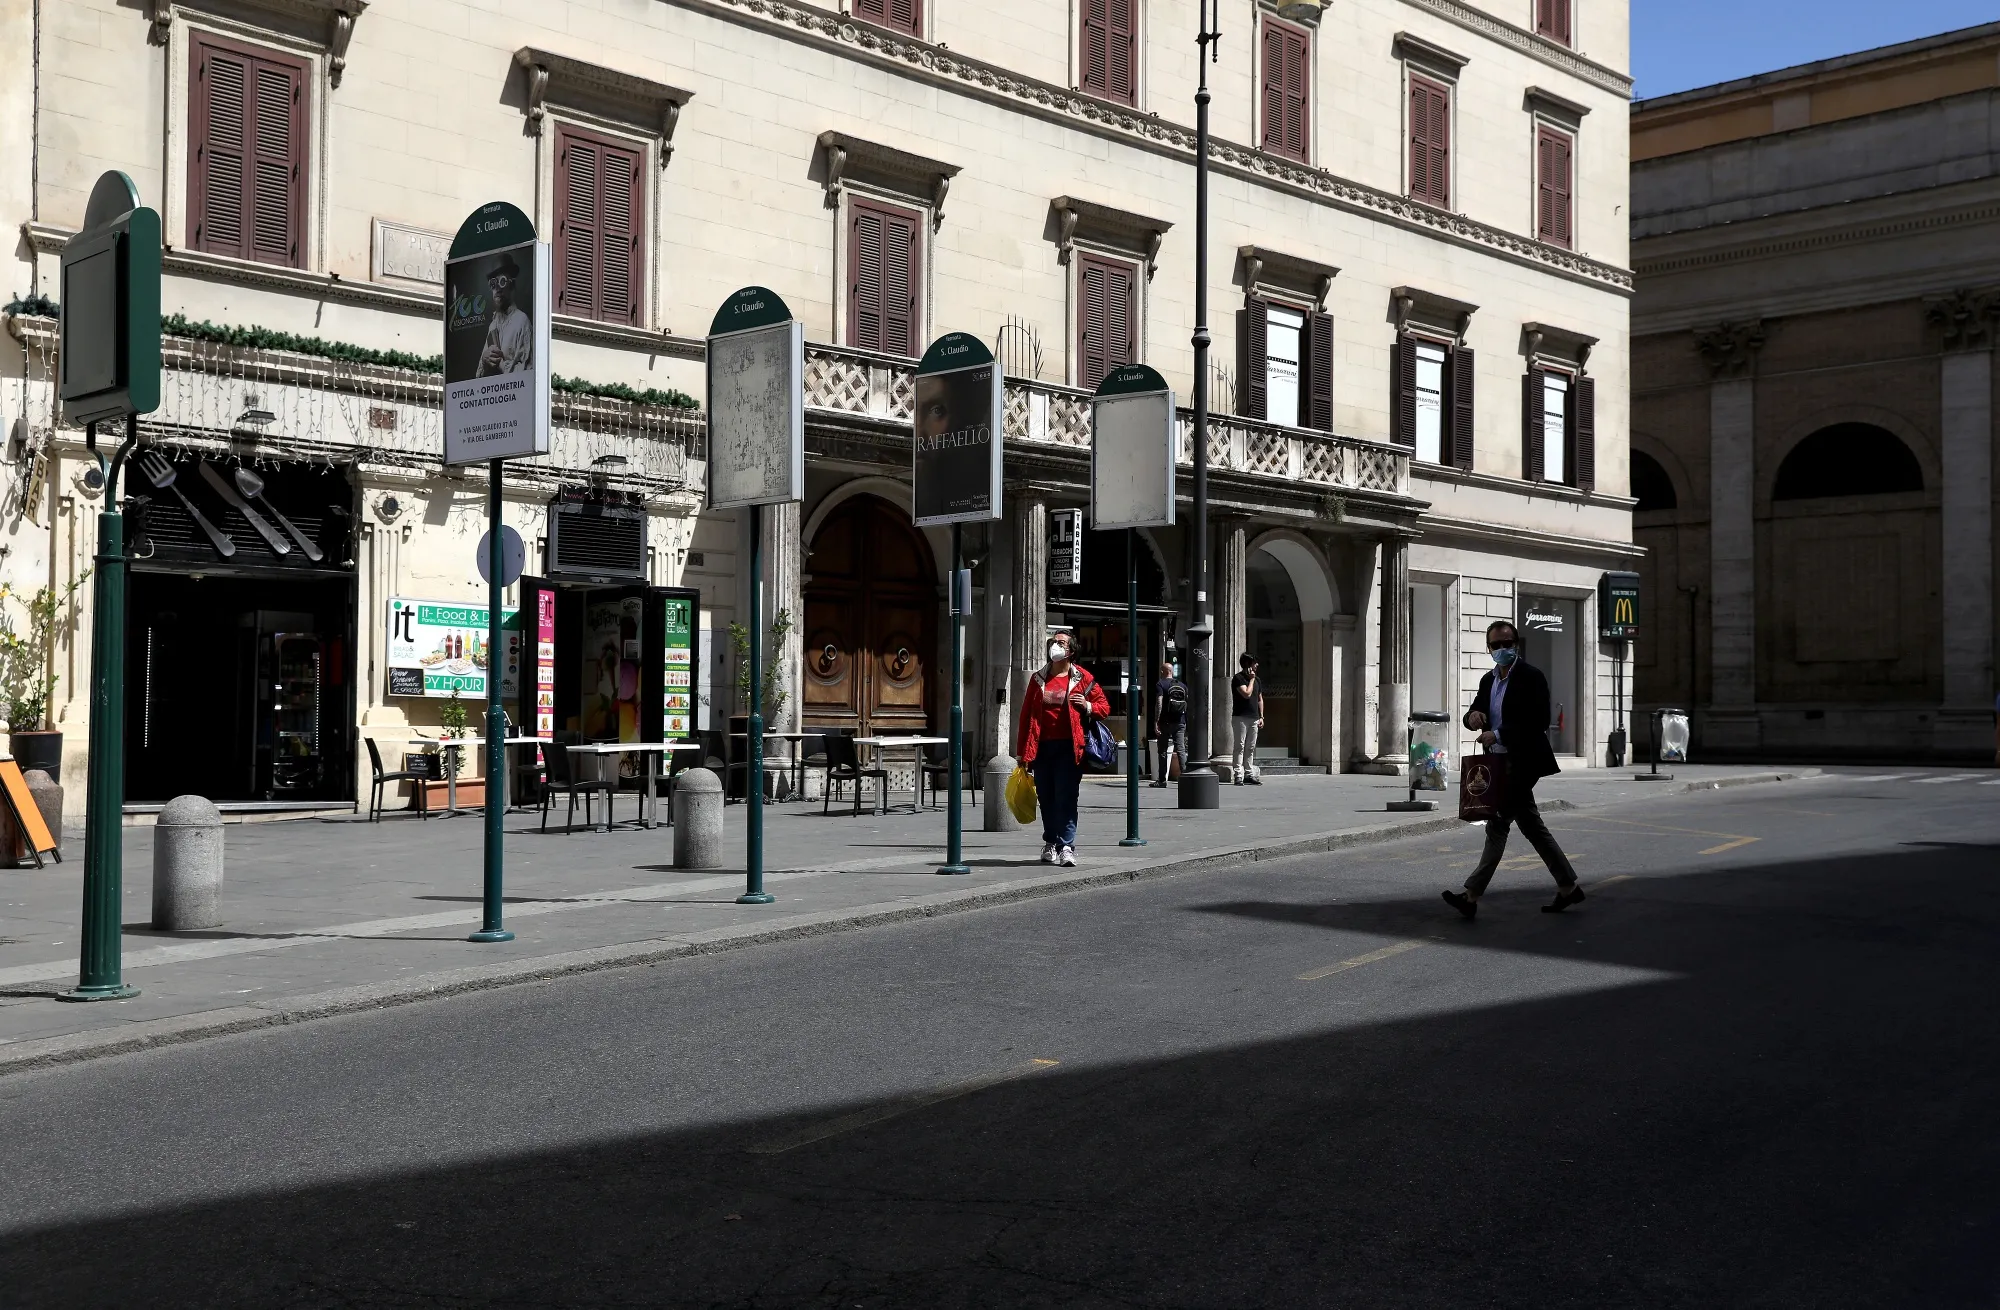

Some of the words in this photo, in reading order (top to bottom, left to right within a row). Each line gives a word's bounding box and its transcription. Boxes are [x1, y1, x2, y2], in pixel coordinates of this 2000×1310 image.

[484, 204, 500, 214] fermata
[476, 223, 483, 234] S.
[484, 218, 509, 232] Claudio
[740, 288, 757, 298] fermata
[734, 304, 740, 314] S.
[741, 300, 765, 313] Claudio
[940, 348, 947, 357] S.
[947, 344, 969, 355] Claudio
[1123, 372, 1144, 381] Claudio
[451, 388, 475, 400] OTTICA
[480, 380, 526, 395] OPTOMETRIA
[459, 393, 517, 410] CONTATTOLOGIA
[472, 425, 482, 433] SAN
[482, 422, 502, 431] CLAUDIO
[467, 436, 476, 444] VIA
[476, 434, 485, 442] DEL
[916, 426, 991, 452] RAFFAELLO
[27, 459, 45, 518] BAR
[1051, 547, 1073, 555] TABACCHI
[393, 600, 416, 643] it
[436, 608, 467, 621] Food
[470, 611, 479, 623] &
[666, 602, 676, 634] FRESH
[443, 678, 482, 691] HOUR
